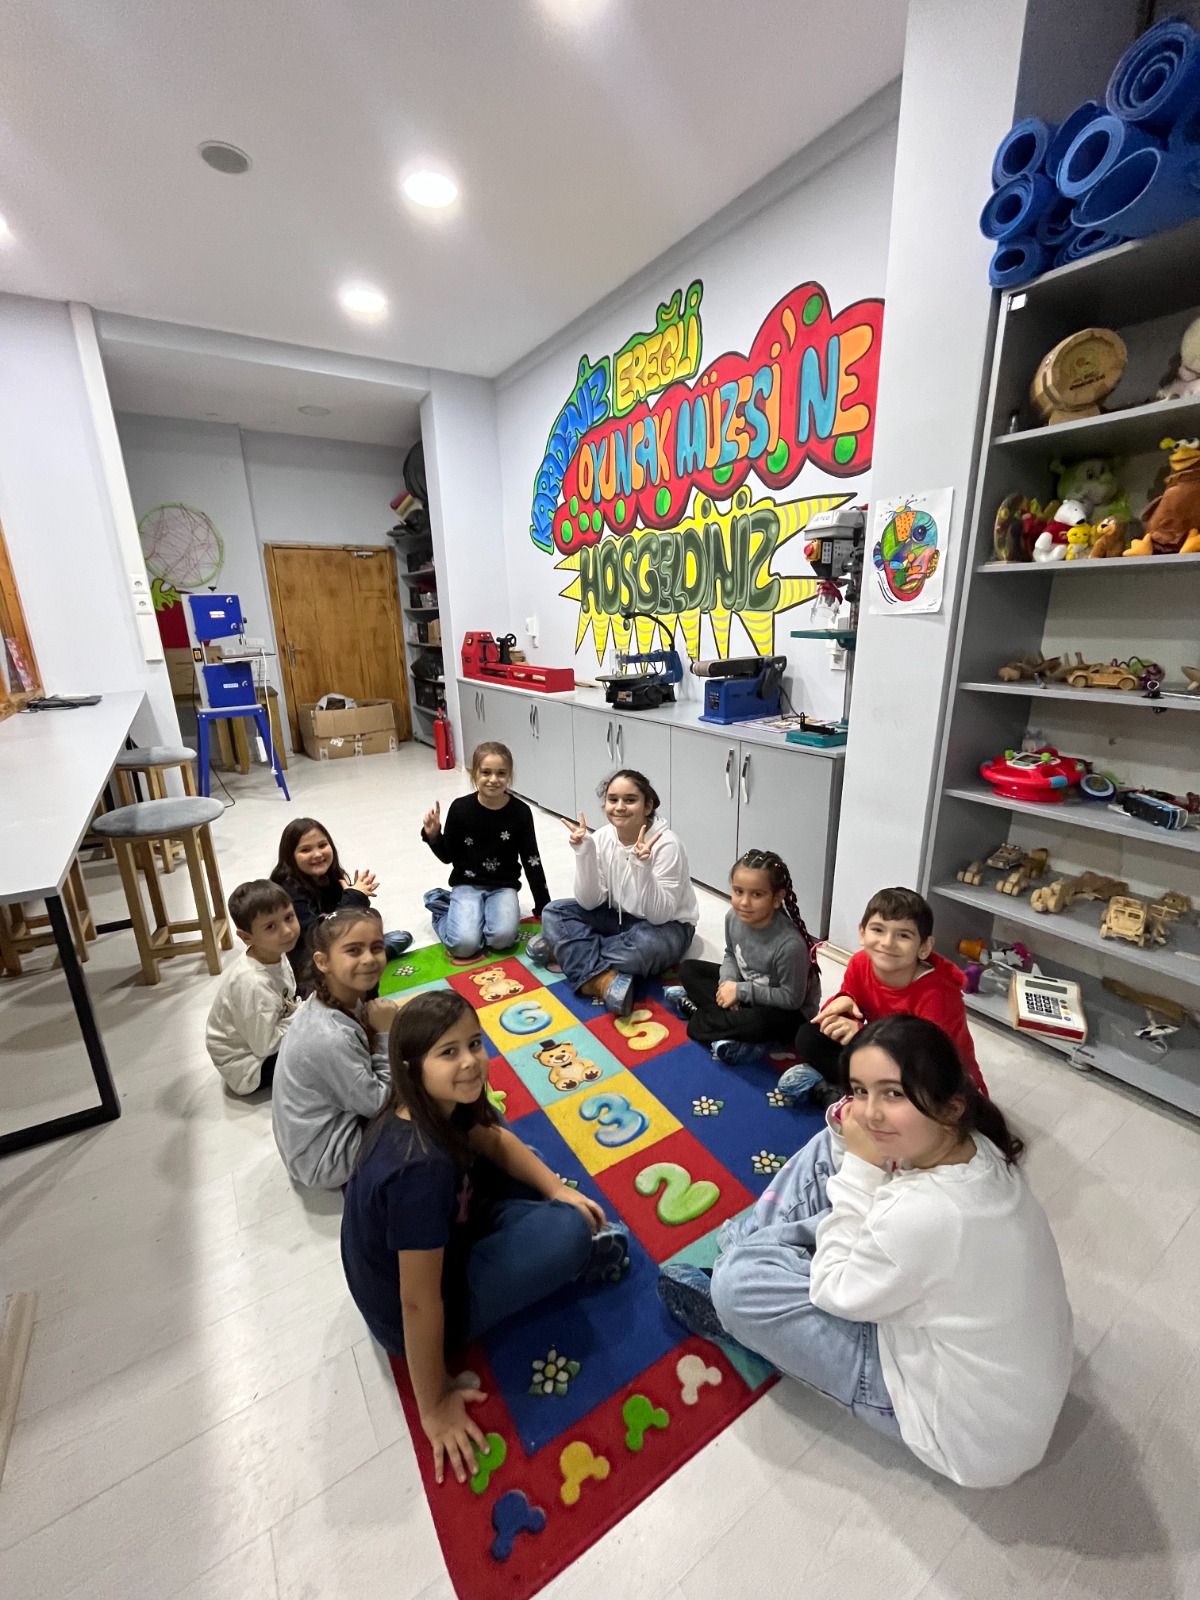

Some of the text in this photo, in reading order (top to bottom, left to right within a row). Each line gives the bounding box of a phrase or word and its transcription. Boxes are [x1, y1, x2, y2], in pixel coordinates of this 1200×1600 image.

[616, 292, 699, 411] EREĞLİ
[577, 407, 671, 504] OYUNCAK
[499, 1000, 553, 1036] 6
[613, 1008, 670, 1051] 5
[578, 1091, 651, 1149] 3
[634, 1161, 721, 1226] 2
